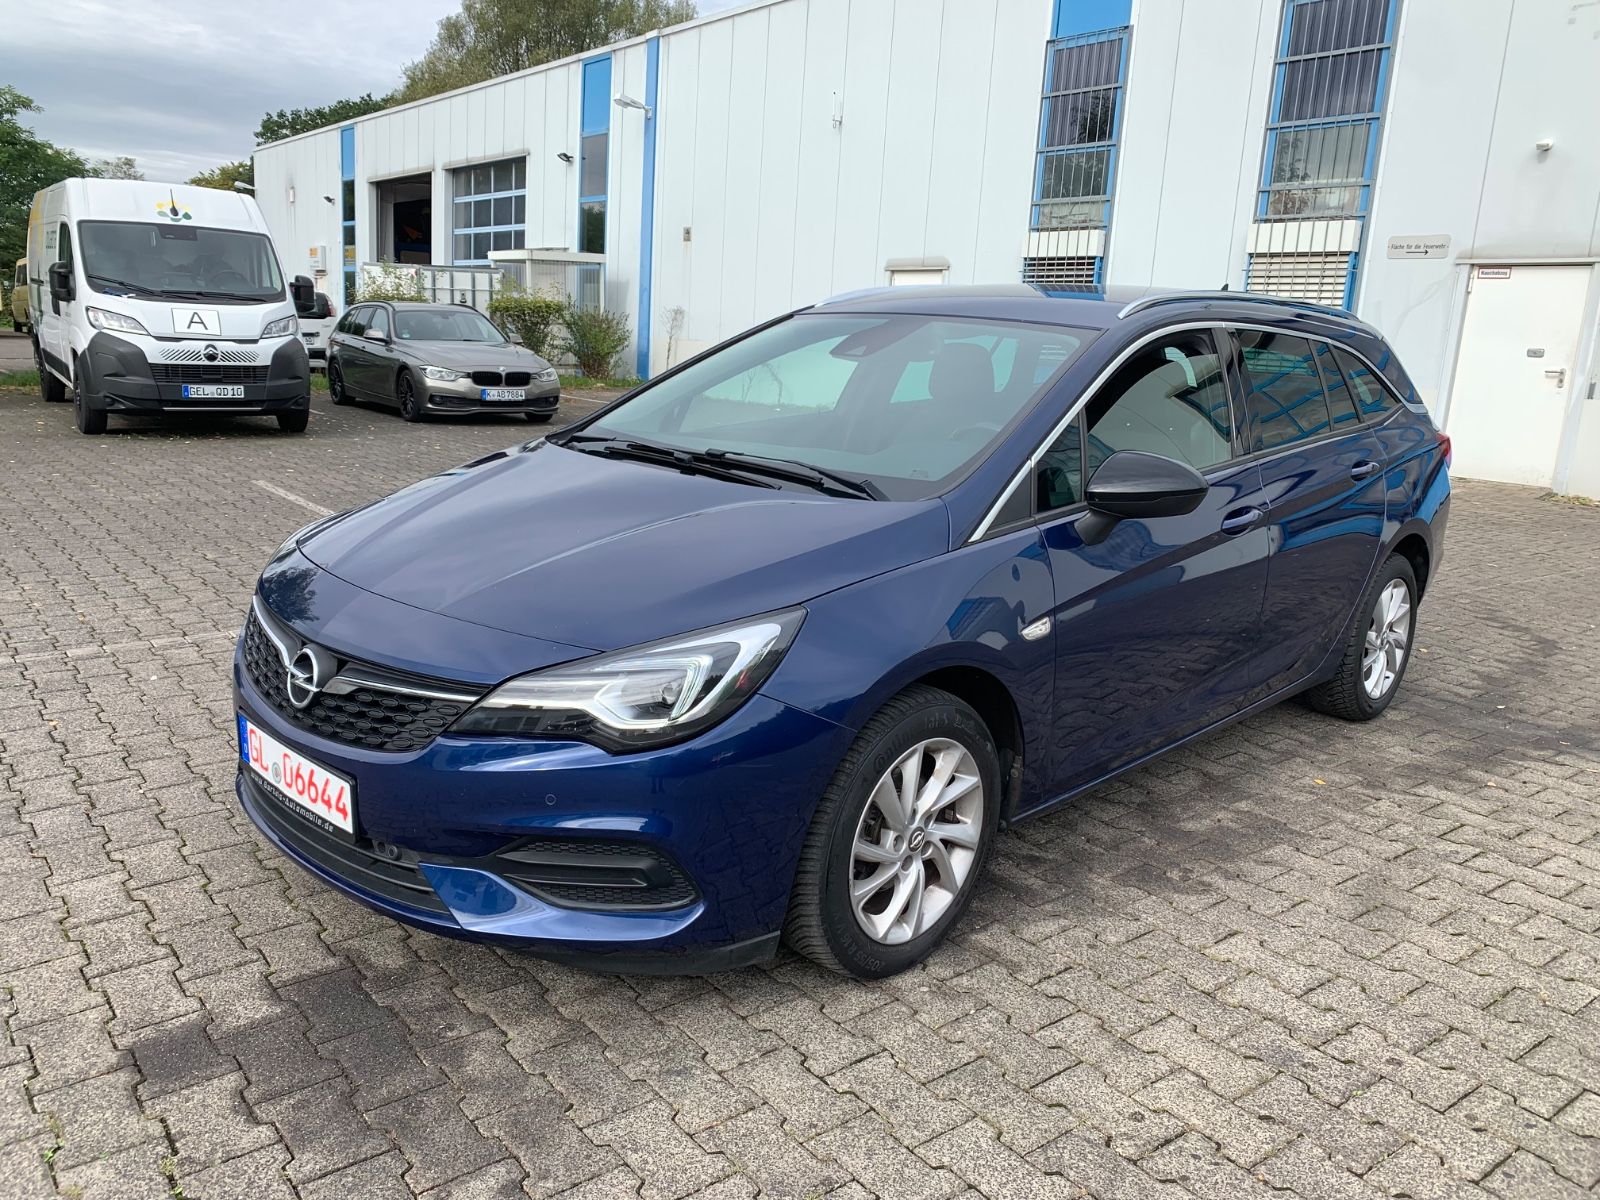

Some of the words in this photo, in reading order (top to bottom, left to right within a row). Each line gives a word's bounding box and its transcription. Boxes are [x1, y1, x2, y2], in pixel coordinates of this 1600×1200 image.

[187, 311, 208, 330] A
[189, 386, 209, 397] GEL
[487, 390, 491, 398] K
[249, 728, 269, 772] GL
[282, 752, 349, 822] 06644
